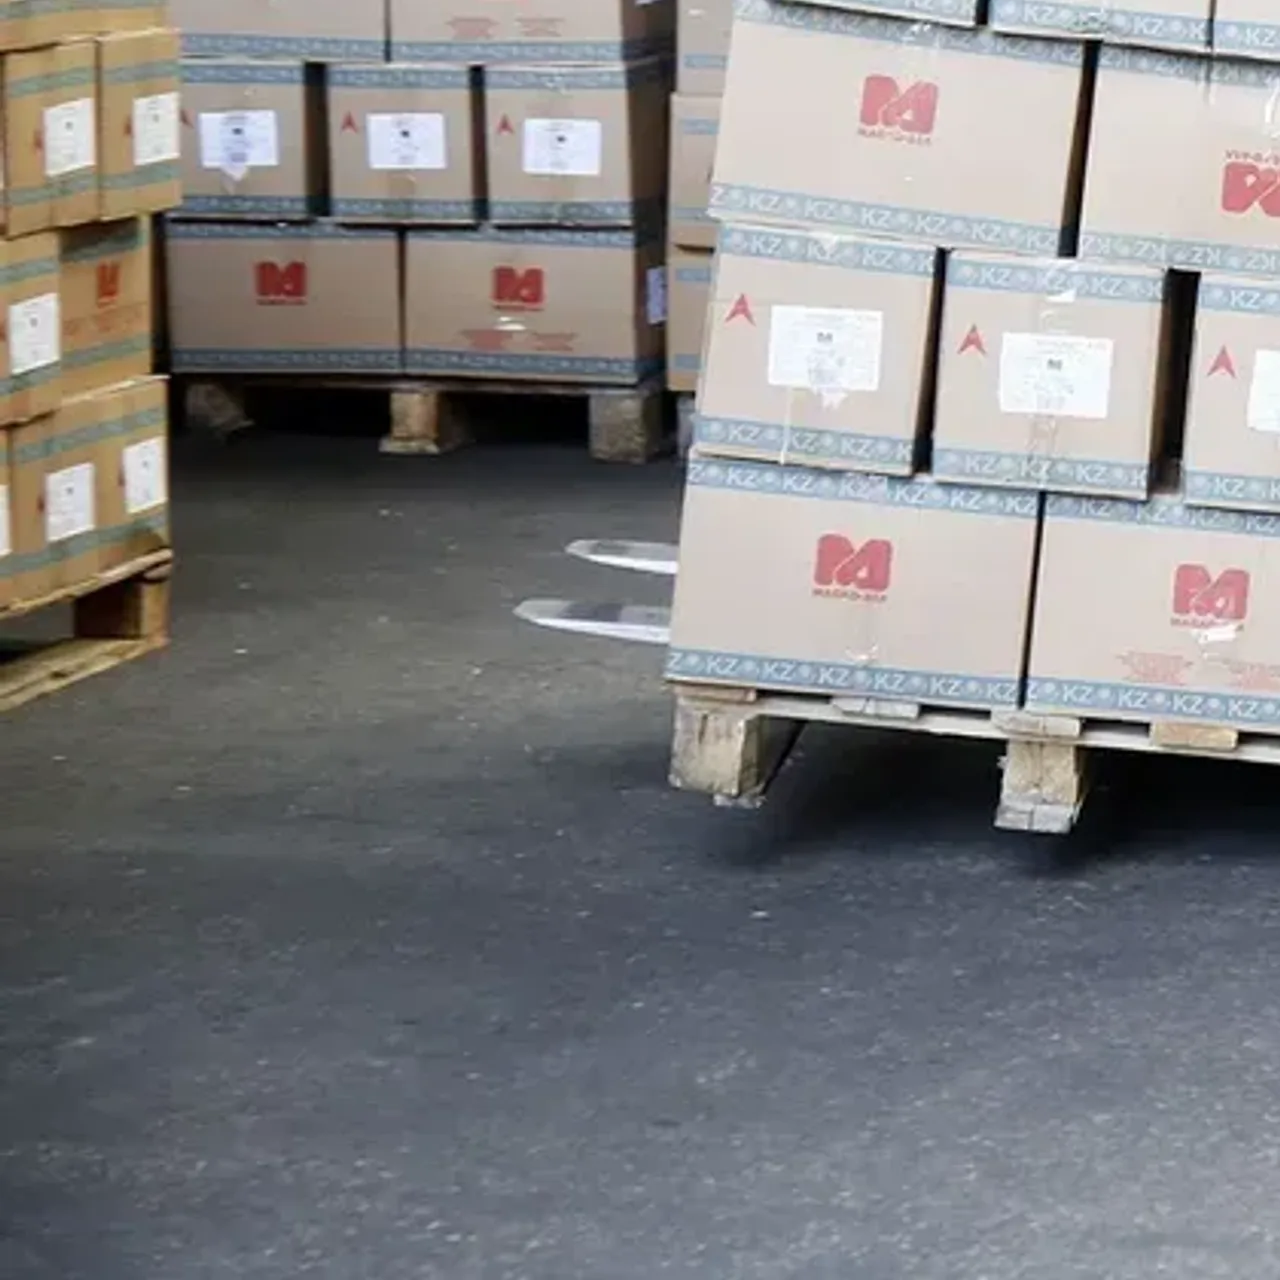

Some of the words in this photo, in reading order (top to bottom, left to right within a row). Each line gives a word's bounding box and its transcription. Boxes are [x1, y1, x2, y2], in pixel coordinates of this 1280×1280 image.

[1023, 5, 1055, 24] KZ
[1133, 17, 1165, 36] KZ
[996, 36, 1028, 55] KZ
[1051, 43, 1083, 62] KZ
[1245, 27, 1276, 46] KZ
[748, 193, 780, 212] KZ
[804, 200, 835, 219] KZ
[860, 208, 892, 227] KZ
[915, 215, 947, 234] KZ
[971, 223, 1002, 242] KZ
[1027, 231, 1058, 250] KZ
[750, 235, 782, 254] KZ
[862, 248, 894, 267] KZ
[1135, 241, 1167, 260] KZ
[1190, 246, 1222, 265] KZ
[1245, 252, 1276, 271] KZ
[980, 266, 1011, 285] KZ
[1091, 276, 1122, 295] KZ
[1230, 289, 1261, 308] KZ
[728, 424, 760, 443] KZ
[840, 437, 872, 456] KZ
[964, 455, 996, 474] KZ
[1075, 464, 1107, 483] KZ
[727, 467, 758, 486] KZ
[782, 473, 814, 492] KZ
[894, 484, 926, 503] KZ
[950, 489, 982, 508] KZ
[1005, 495, 1036, 514] KZ
[1213, 477, 1245, 496] KZ
[1135, 503, 1167, 522] KZ
[1245, 514, 1277, 533] KZ
[706, 656, 738, 675] KZ
[762, 662, 794, 681] KZ
[818, 667, 850, 686] KZ
[874, 672, 905, 691] KZ
[930, 677, 961, 696] KZ
[985, 682, 1016, 701] KZ
[1062, 684, 1093, 703] KZ
[1117, 689, 1149, 708] KZ
[1172, 694, 1204, 713] KZ
[1228, 699, 1259, 718] KZ
